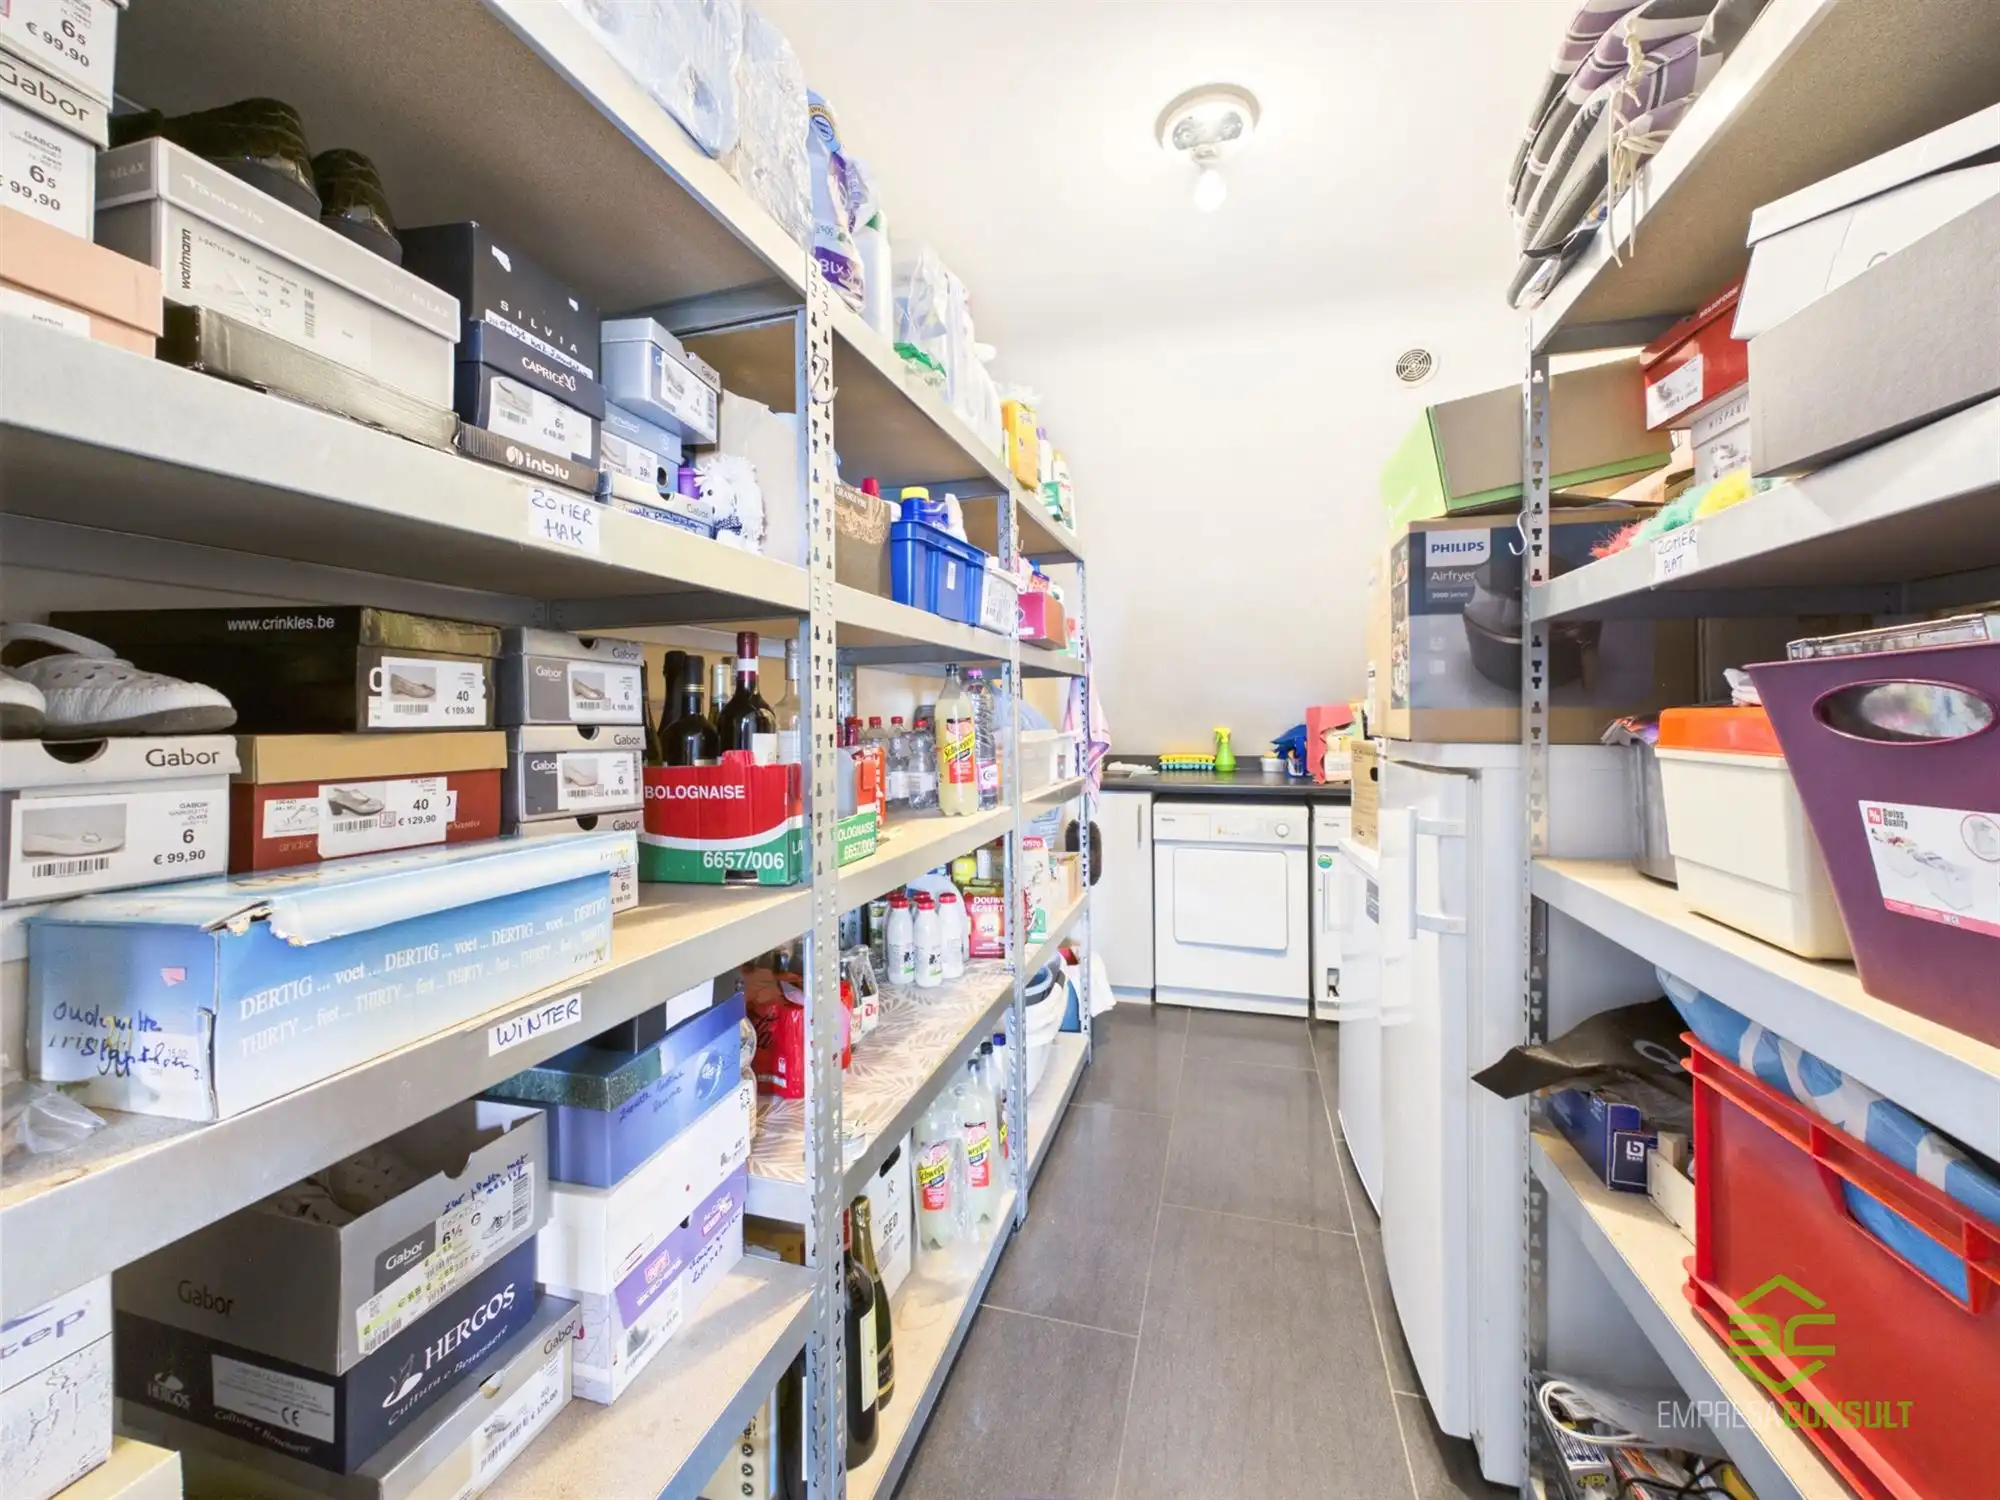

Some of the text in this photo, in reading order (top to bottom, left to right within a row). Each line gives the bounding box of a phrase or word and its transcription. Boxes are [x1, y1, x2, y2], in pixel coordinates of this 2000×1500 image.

[179, 228, 191, 290] wortmann
[500, 300, 578, 354] SILVIA
[521, 356, 567, 388] CAPRICE
[1708, 400, 1748, 432] HISPANI
[526, 452, 570, 480] inblu
[531, 488, 594, 526] ZOMER
[542, 518, 583, 544] HAK
[1431, 541, 1485, 554] PHILIPS
[1657, 529, 1697, 555] ZOMER
[1431, 569, 1476, 582] Airfryer
[227, 614, 336, 631] www.crinkles.be
[612, 647, 640, 660] Gabor
[535, 665, 563, 678] Gabor
[456, 690, 470, 702] 40
[613, 734, 641, 746] Gabor
[145, 748, 220, 768] Gabor
[644, 784, 746, 801] BOLOGNAISE
[412, 798, 430, 811] 40
[1882, 807, 1905, 819] Swiss
[613, 820, 641, 832] Gabor
[1883, 817, 1909, 830] Quality
[182, 828, 195, 844] 6
[167, 849, 206, 864] 99,90
[703, 851, 785, 870] 6657/006
[240, 975, 313, 1021] DERTIG
[333, 961, 365, 985] voet
[385, 943, 440, 973] DERTIG
[492, 922, 534, 946] DERTIG
[241, 1016, 299, 1059] THIRTY
[385, 1240, 425, 1270] Gabor
[177, 1278, 234, 1317] Gabor
[424, 1282, 517, 1371] HERGOS
[543, 1319, 577, 1356] Gabor
